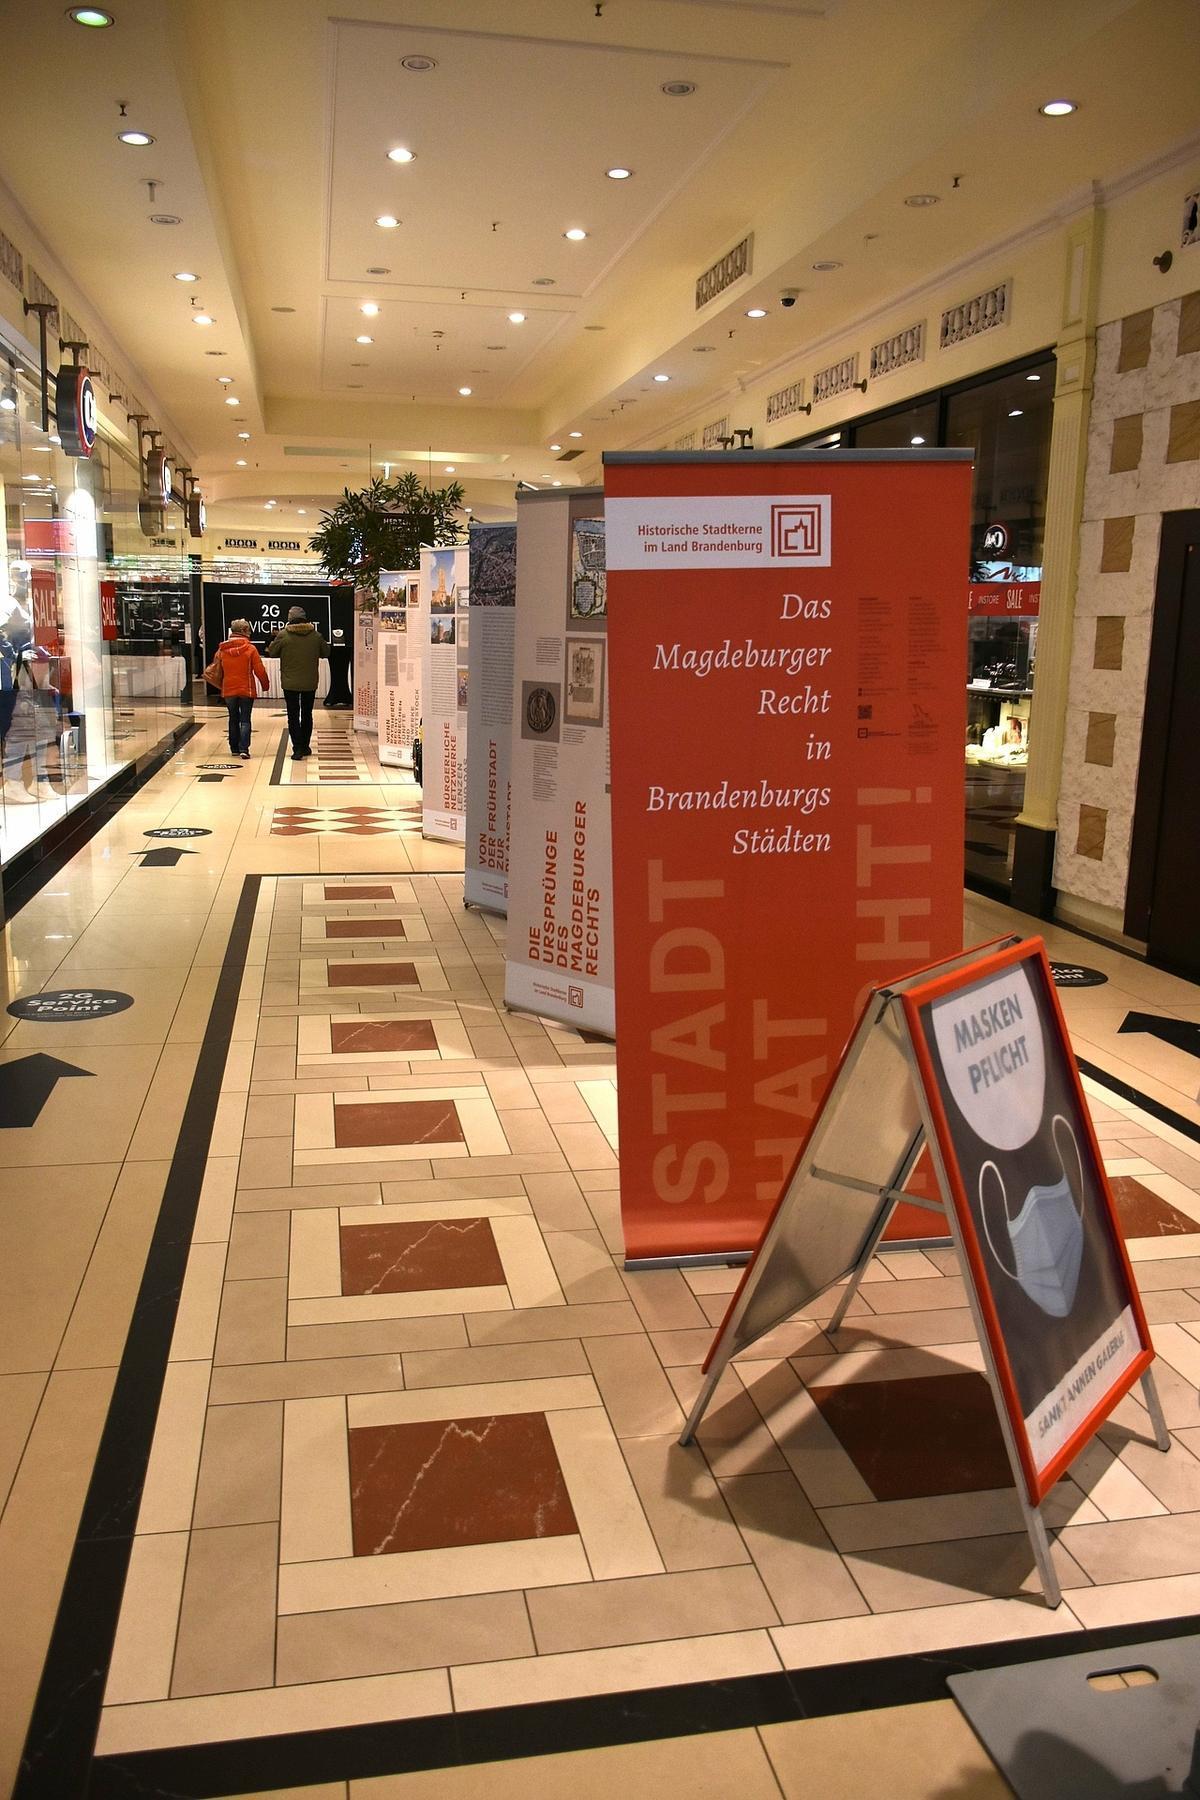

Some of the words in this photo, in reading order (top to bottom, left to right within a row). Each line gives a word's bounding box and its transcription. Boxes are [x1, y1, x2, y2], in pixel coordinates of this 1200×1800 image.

[637, 523, 699, 537] Historische
[702, 523, 763, 535] Stadtkerne
[643, 541, 658, 553] im
[661, 541, 688, 553] Land
[691, 540, 763, 554] Brandenburg
[33, 589, 57, 628] SALE
[102, 596, 116, 626] SALE
[261, 604, 280, 617] 2G
[779, 593, 832, 620] Das
[1006, 588, 1023, 609] SALE
[653, 639, 832, 677] Magdeburger
[757, 685, 832, 715] Recht
[805, 733, 832, 761] in
[487, 739, 497, 832] FRÜHSTADT
[646, 779, 832, 815] Brandenburgs
[479, 833, 487, 865] VON
[488, 837, 496, 868] DER
[496, 838, 504, 871] ZUR
[732, 825, 831, 855] Städten
[542, 830, 557, 964] URSPRÜNGE
[570, 800, 587, 972] MAGDEBURGER
[529, 926, 541, 961] DIE
[556, 926, 568, 968] DES
[586, 888, 600, 976] RECHTS
[26, 998, 118, 1006] Service
[37, 1004, 102, 1012] Point
[647, 859, 729, 1205] STADT
[953, 993, 1023, 1053] MASKEN
[967, 1035, 1029, 1095] PFLICHT
[1038, 1395, 1068, 1438] SANKT
[1067, 1362, 1097, 1402] ANNEN
